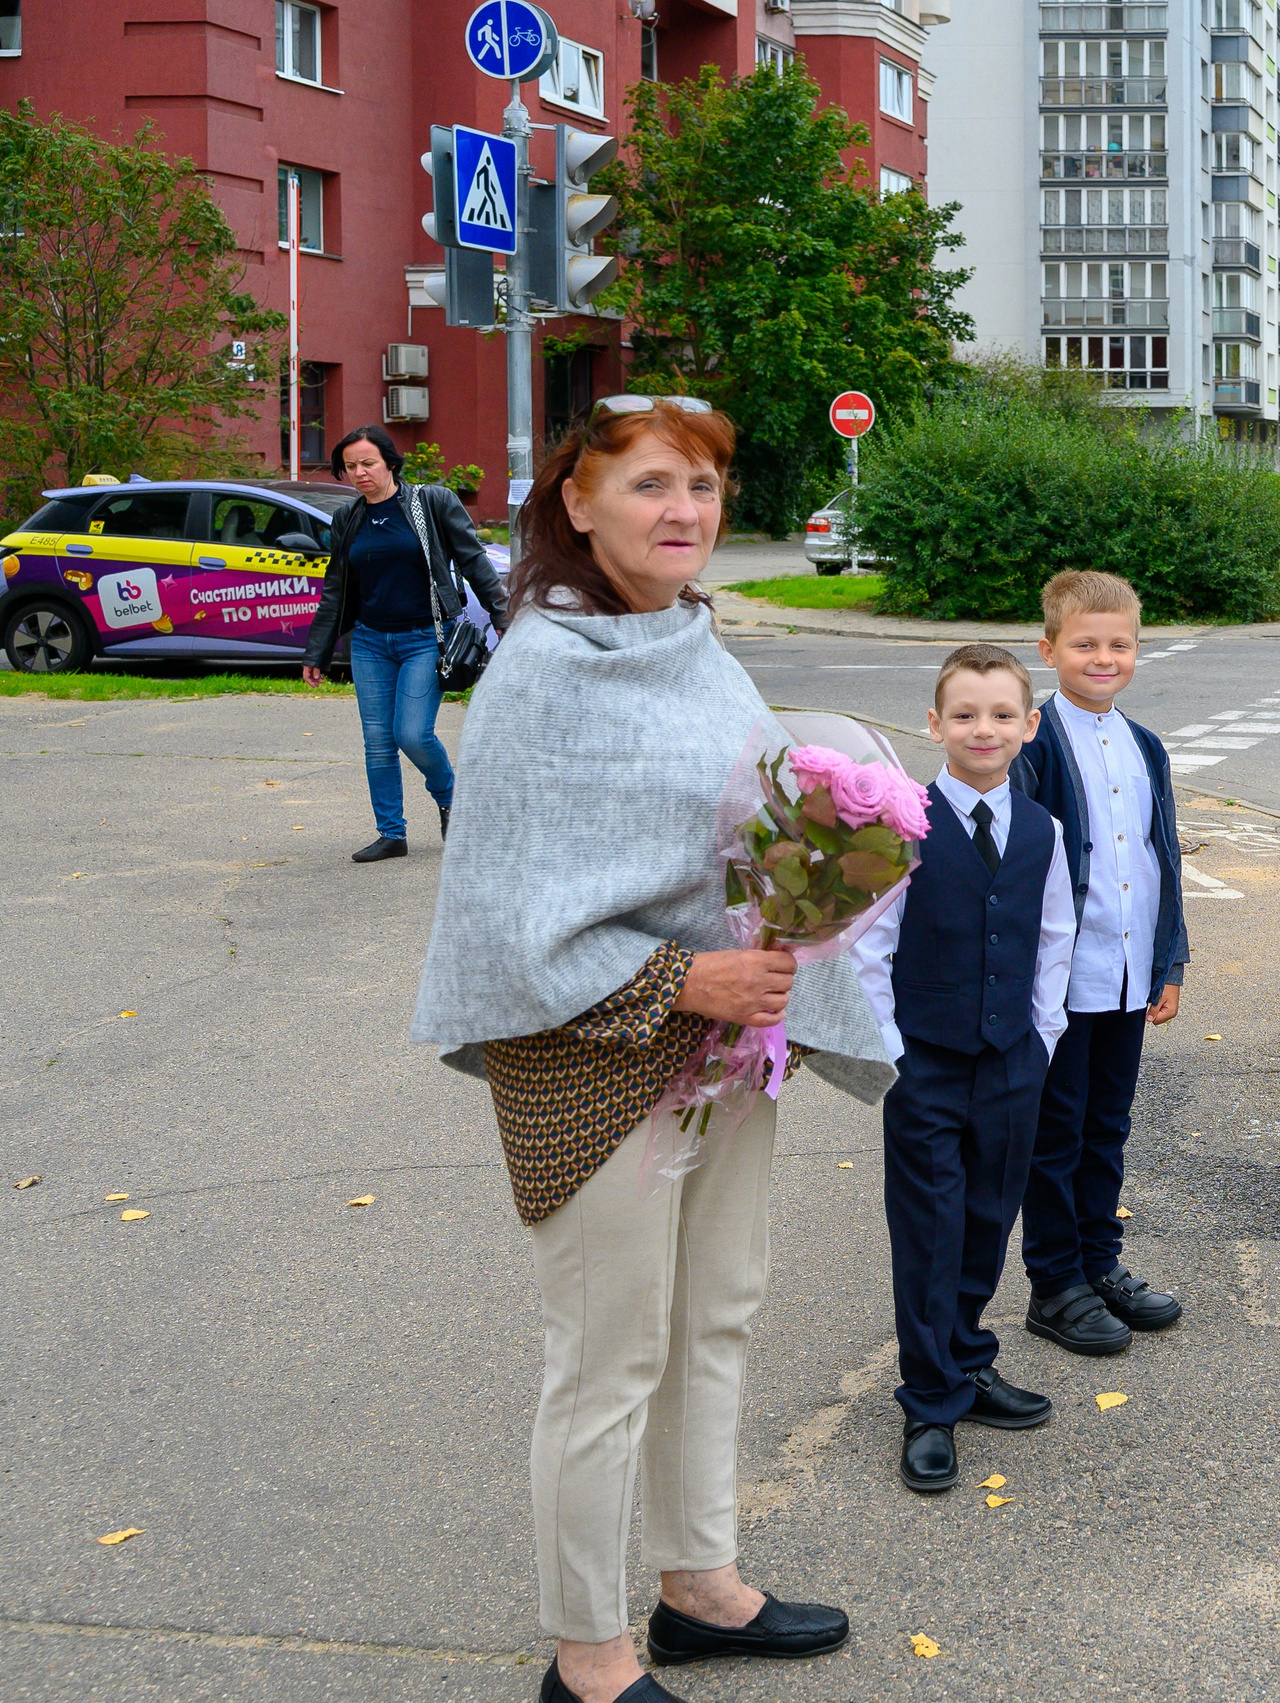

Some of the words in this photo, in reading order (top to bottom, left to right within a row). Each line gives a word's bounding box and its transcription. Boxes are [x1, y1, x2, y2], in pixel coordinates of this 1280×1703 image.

[29, 536, 57, 546] E485
[190, 576, 318, 605] Счастливчики,
[113, 600, 154, 618] belbet
[222, 606, 252, 624] по
